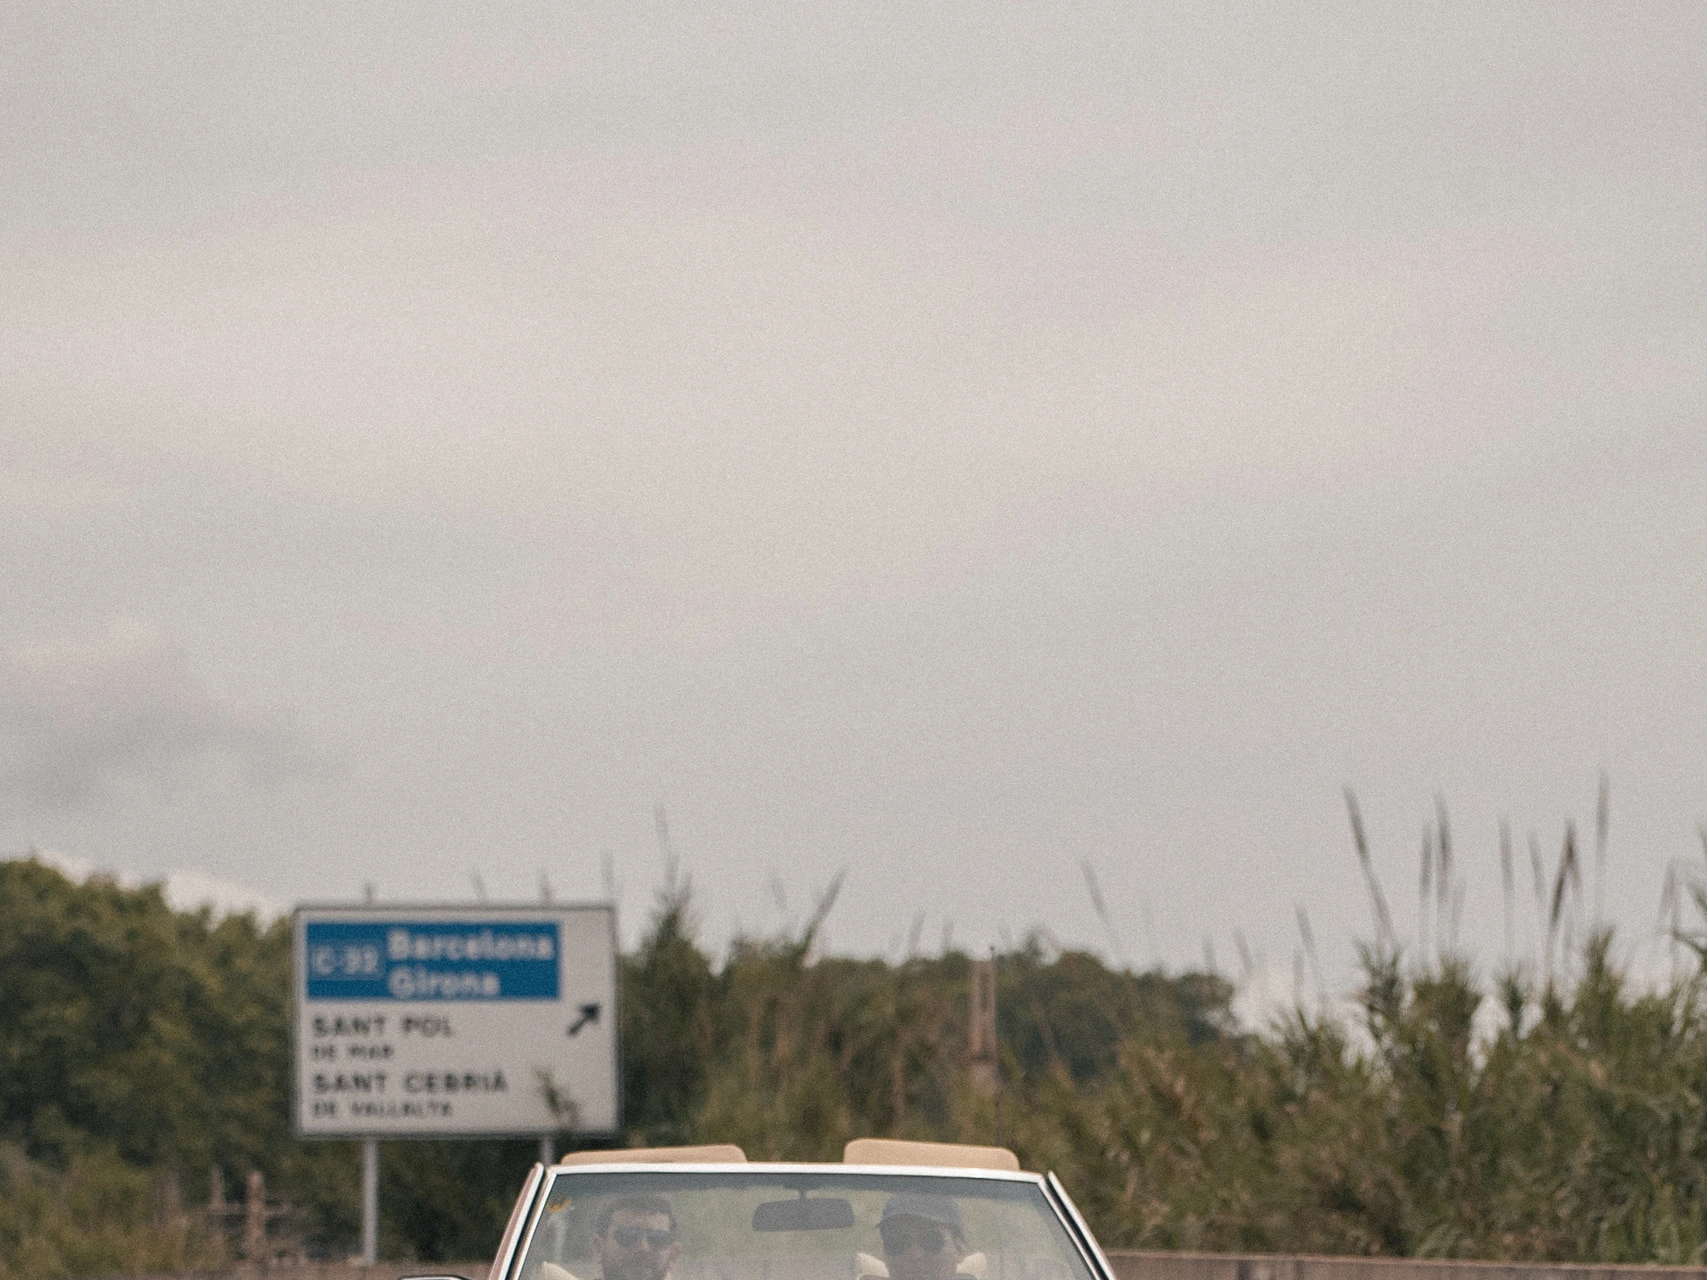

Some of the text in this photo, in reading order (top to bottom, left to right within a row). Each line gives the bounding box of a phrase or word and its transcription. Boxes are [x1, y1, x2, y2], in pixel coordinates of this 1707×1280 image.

[387, 929, 554, 961] Barcelona
[387, 966, 500, 998] Girona
[312, 1016, 454, 1038] SANT POL
[312, 1073, 388, 1094] SANT
[312, 1100, 337, 1117] DE
